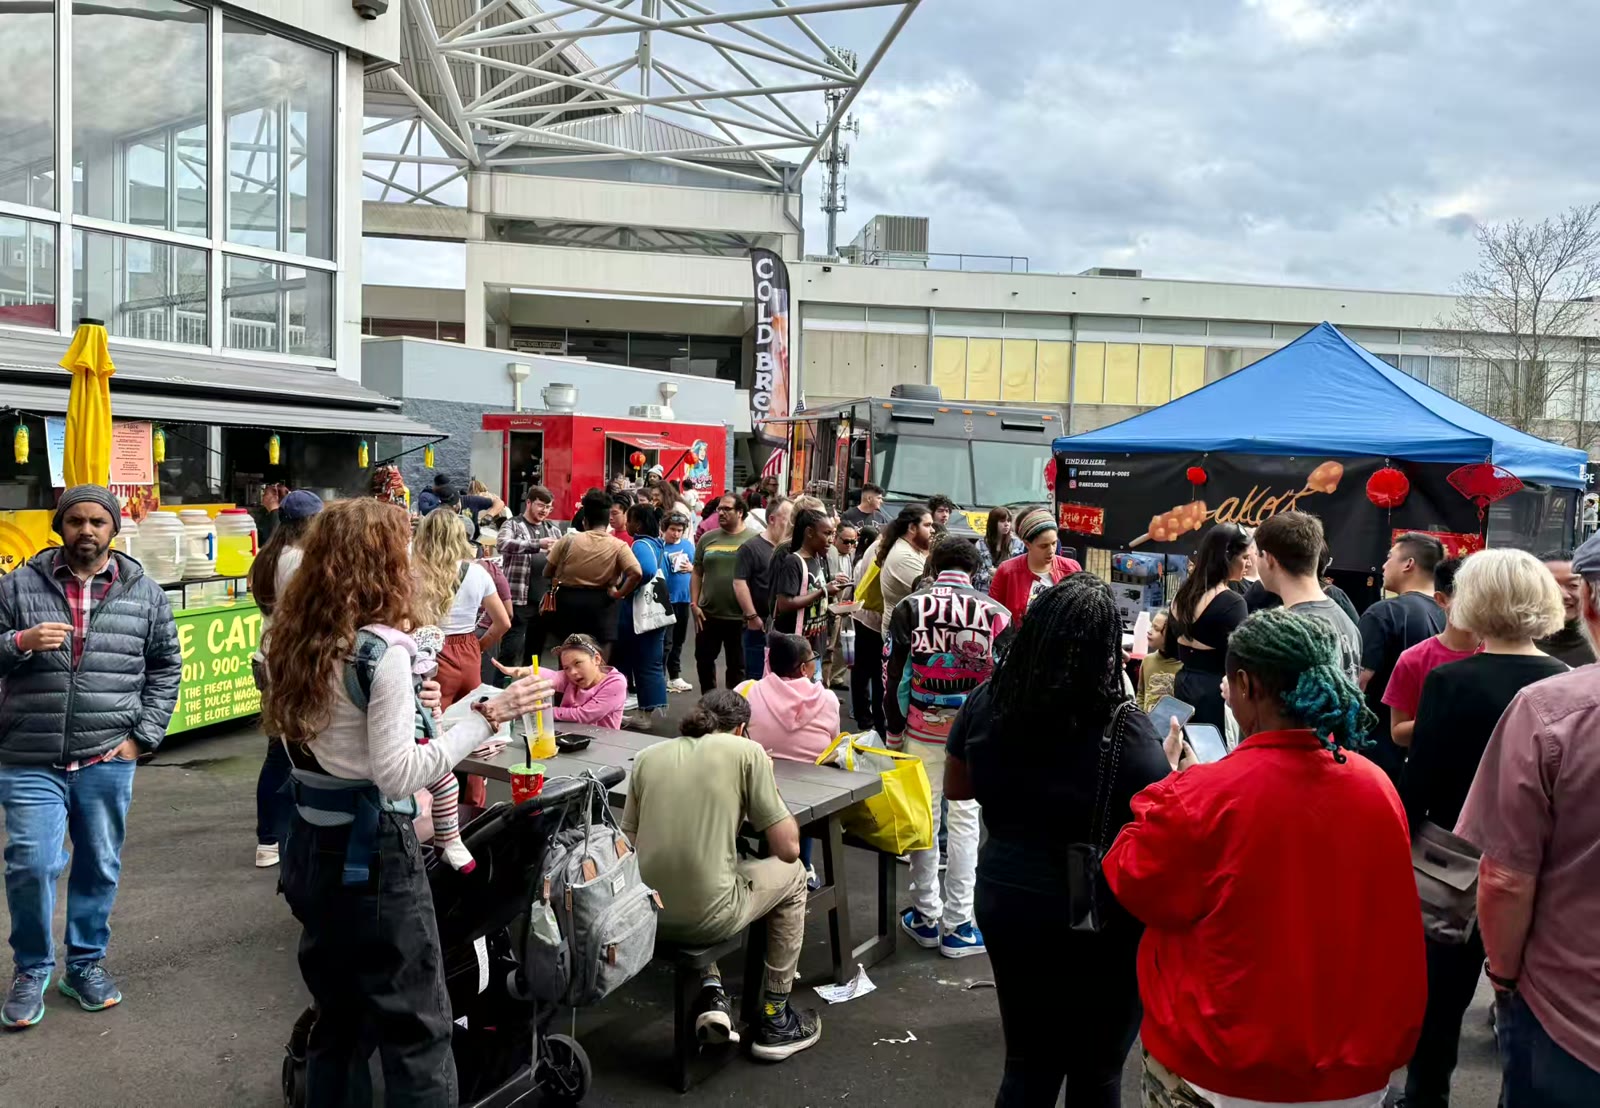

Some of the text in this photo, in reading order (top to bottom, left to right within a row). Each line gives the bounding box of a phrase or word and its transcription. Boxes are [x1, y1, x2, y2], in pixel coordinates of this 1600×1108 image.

[750, 258, 774, 431] COLD BREW
[930, 586, 953, 596] THE
[911, 594, 997, 631] PINK
[207, 613, 264, 654] CAT
[184, 686, 201, 699] THE
[204, 680, 233, 695] FIESTA
[185, 700, 201, 713] THE
[205, 693, 231, 707] DULCE
[185, 714, 202, 726] THE
[205, 707, 230, 721] ELOTE
